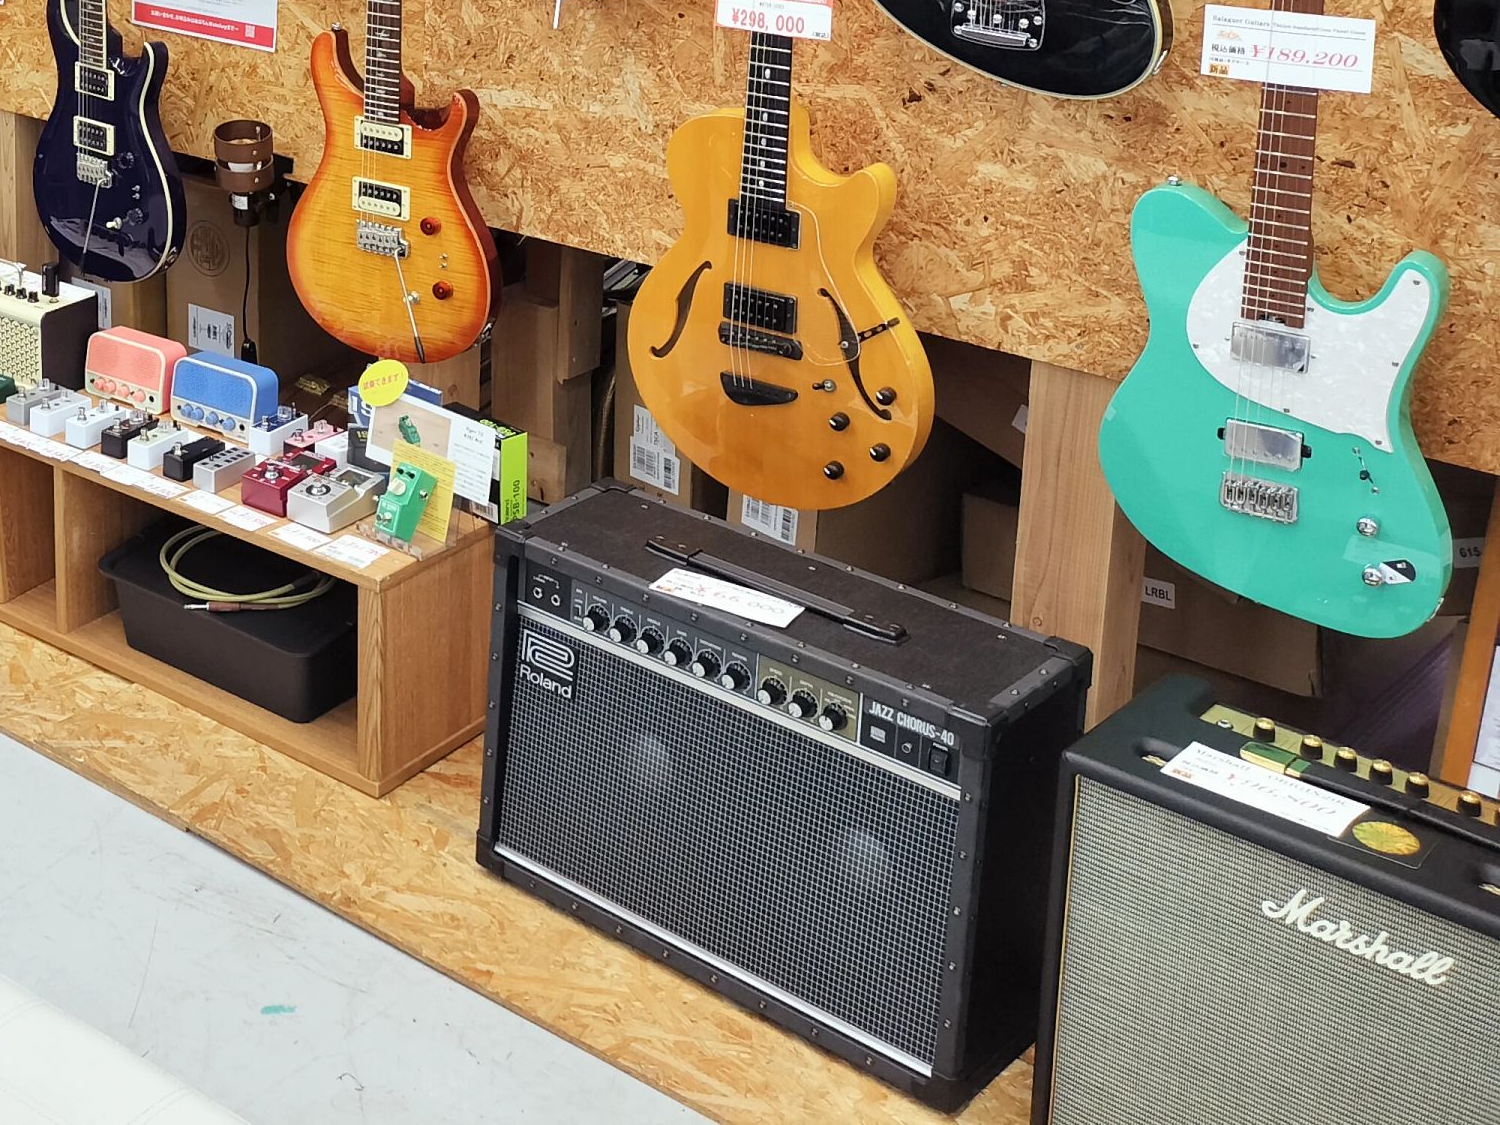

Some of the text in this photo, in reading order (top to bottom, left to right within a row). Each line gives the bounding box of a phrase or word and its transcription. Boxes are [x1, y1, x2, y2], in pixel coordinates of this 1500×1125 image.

[731, 7, 805, 33] ¥298,000
[1211, 43, 1359, 68] 税込価格 ¥189,200
[1144, 586, 1172, 603] LRBL
[519, 663, 572, 699] Roland
[869, 700, 955, 746] JAZZ CHORUS-40
[1262, 888, 1456, 988] Marshall
